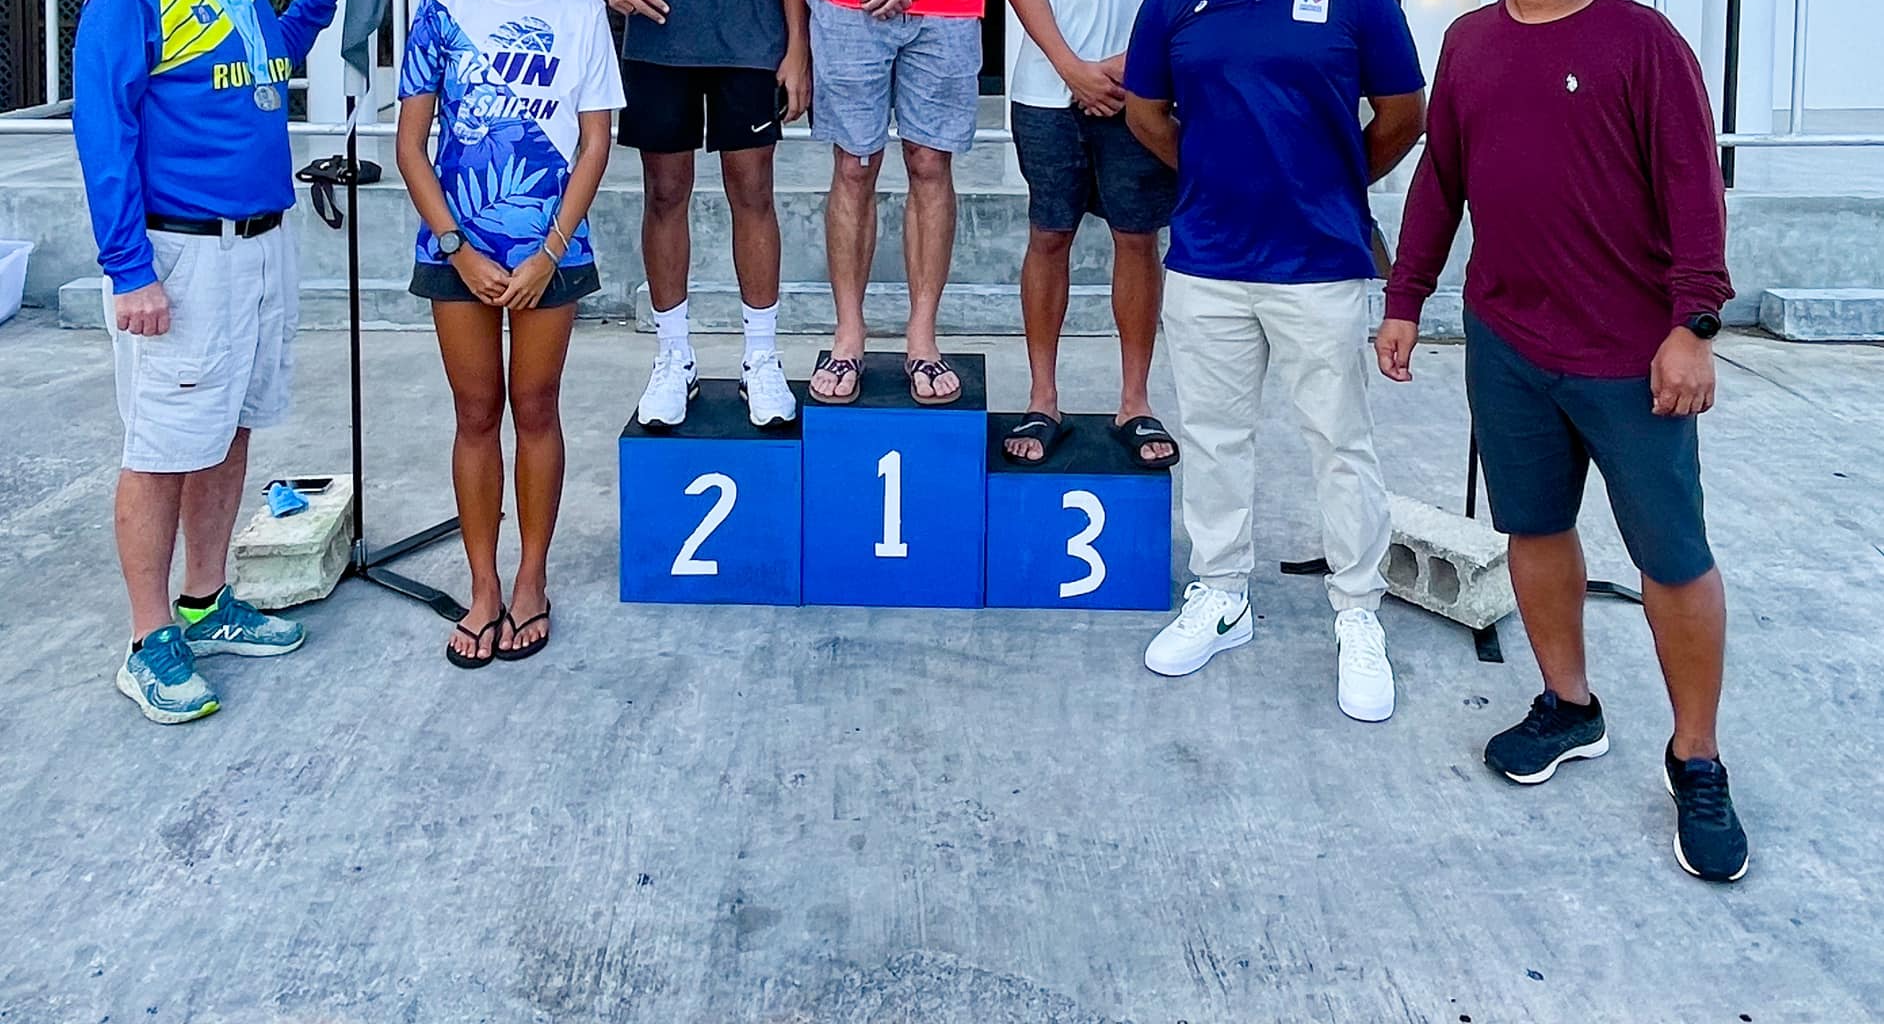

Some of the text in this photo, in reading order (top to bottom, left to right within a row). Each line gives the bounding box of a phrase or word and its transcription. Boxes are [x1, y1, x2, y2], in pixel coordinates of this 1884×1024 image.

[457, 50, 561, 87] RUN
[473, 94, 560, 121] SAIPAN
[670, 471, 738, 577] 2
[873, 448, 908, 558] 1
[1058, 489, 1107, 599] 3
